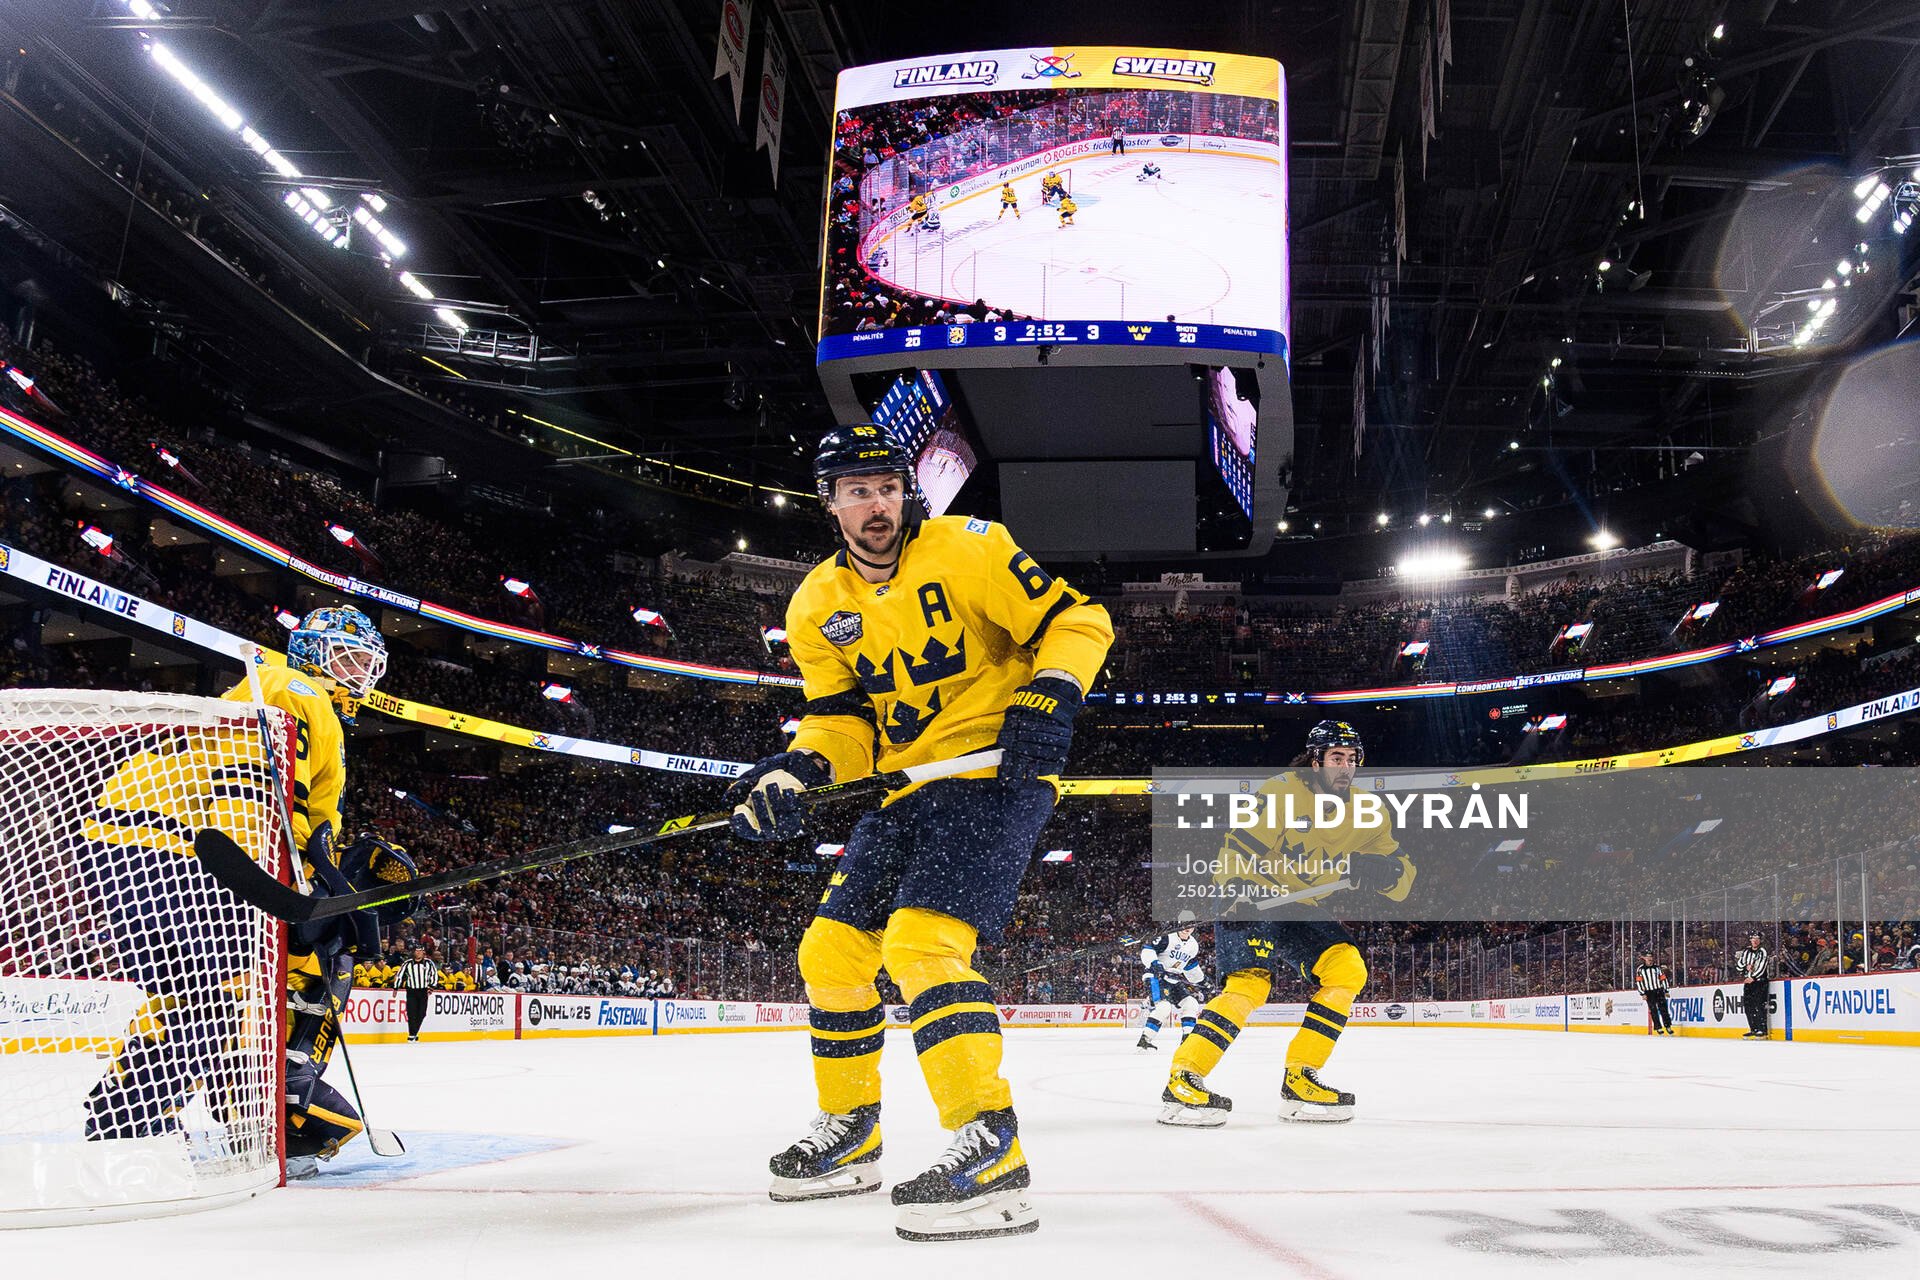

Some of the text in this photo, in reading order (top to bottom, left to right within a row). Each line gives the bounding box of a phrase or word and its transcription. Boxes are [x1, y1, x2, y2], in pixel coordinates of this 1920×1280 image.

[896, 61, 997, 86] FINLAND
[1114, 57, 1213, 77] SWEDEN
[1053, 144, 1090, 161] ROGERS
[1093, 138, 1151, 150] tickeaster
[994, 326, 1006, 341] 3
[1026, 324, 1065, 337] 2:52
[1087, 325, 1099, 340] 3
[1179, 333, 1195, 343] 20
[1223, 328, 1257, 337] PENALTIES
[905, 337, 921, 348] 20
[46, 567, 140, 618] FINLANDE
[351, 581, 368, 594] DES
[379, 589, 420, 610] NATIONS
[917, 582, 952, 628] A
[821, 614, 861, 634] NATIONS
[759, 674, 805, 686] CONFRONTA
[1457, 680, 1518, 692] CONFRONTATION
[1519, 678, 1534, 686] DES
[1544, 671, 1583, 682] NATIONS
[1011, 691, 1058, 714] RIOR
[1153, 694, 1160, 703] 3
[1190, 694, 1198, 703] 3
[1862, 691, 1920, 720] FINLAND
[667, 756, 739, 776] FINLANDE
[435, 995, 505, 1015] BODYARMOR
[1666, 998, 1705, 1022] STENAL
[1726, 995, 1744, 1014] NH
[1824, 988, 1896, 1014] FANDUEL
[345, 999, 407, 1023] ROGER
[544, 1005, 568, 1019] NHL
[576, 1006, 592, 1020] 25
[598, 1001, 648, 1025] FASTENAL
[676, 1007, 707, 1020] FANDUEL
[755, 1004, 782, 1023] TYLENOL
[1020, 1010, 1073, 1019] CANADIAN TIRE
[1082, 1005, 1140, 1021] TYLENO
[470, 1017, 504, 1027] Sports Drink
